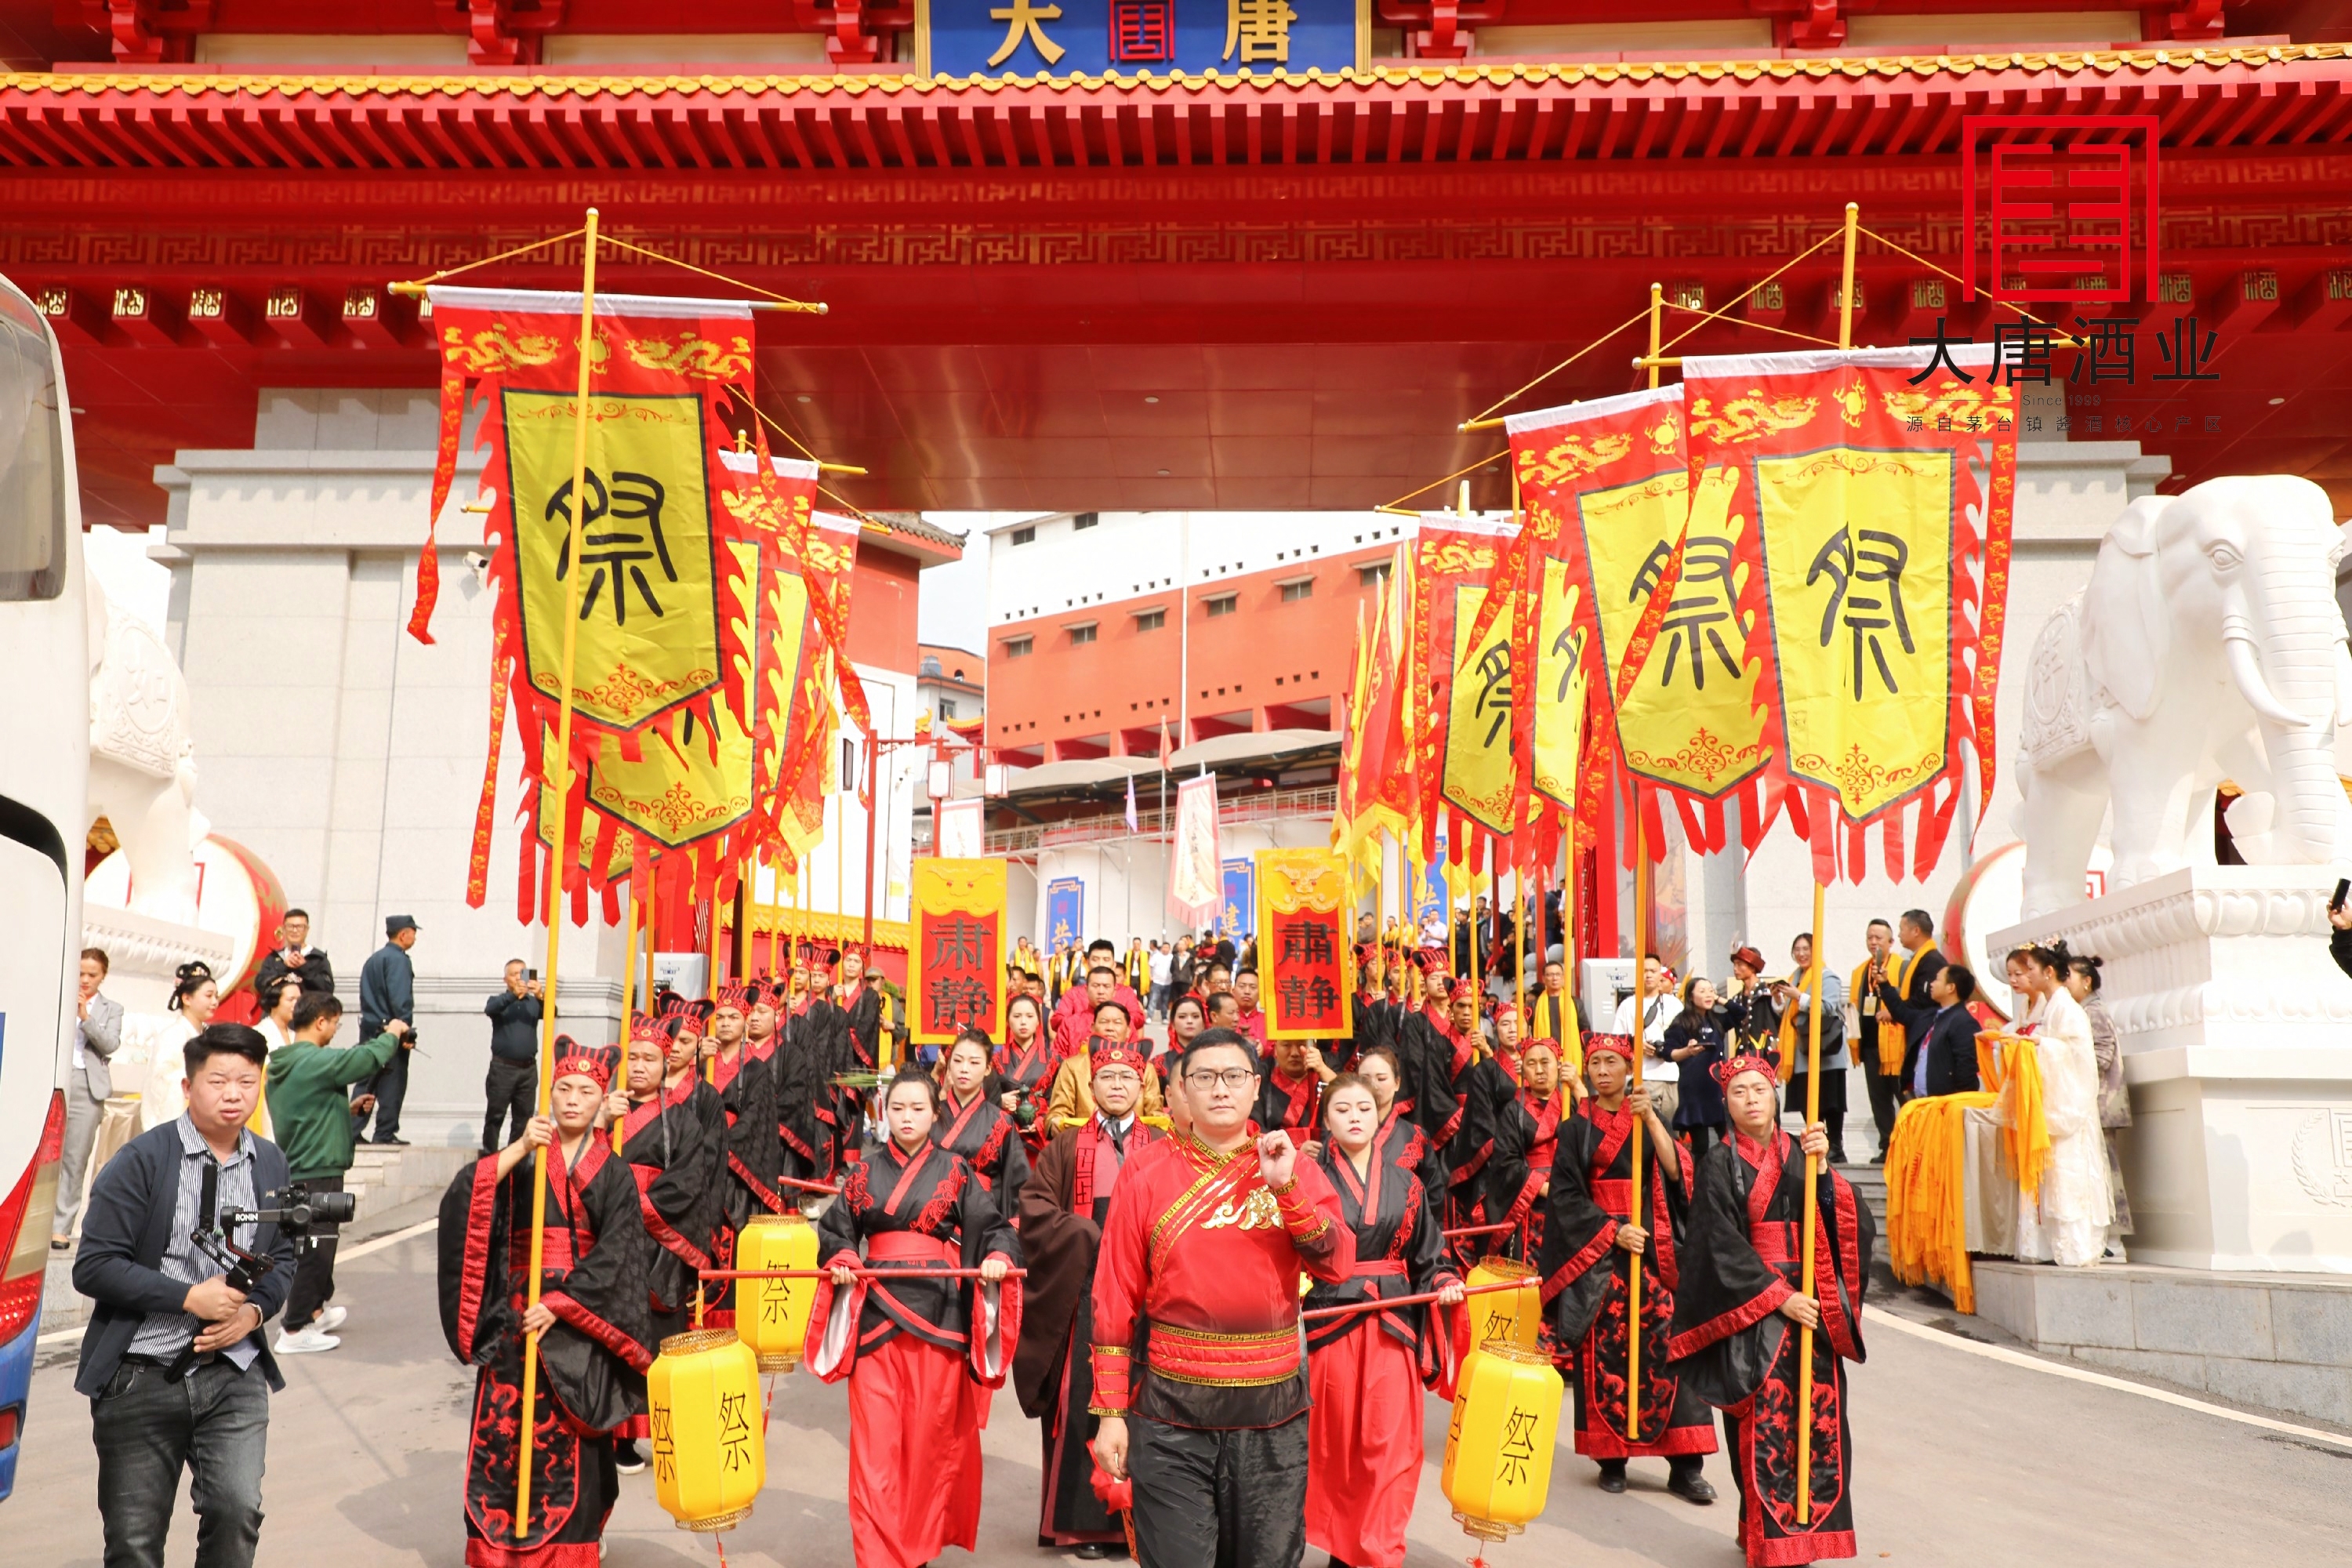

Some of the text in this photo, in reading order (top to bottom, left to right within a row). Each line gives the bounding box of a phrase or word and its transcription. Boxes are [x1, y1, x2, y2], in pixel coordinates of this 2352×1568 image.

[1914, 280, 1944, 308] 酒
[2159, 274, 2193, 303] 酒
[2244, 272, 2278, 300] 酒
[545, 466, 679, 626] 祭
[1628, 536, 1749, 691] 祭
[1806, 521, 1916, 702] 祭
[929, 916, 993, 1029] 肃静
[235, 1212, 258, 1222] RONIN
[761, 1258, 791, 1324] 祭
[652, 1400, 676, 1484] 祭
[719, 1391, 751, 1472] 祭
[1497, 1405, 1539, 1486] 祭
